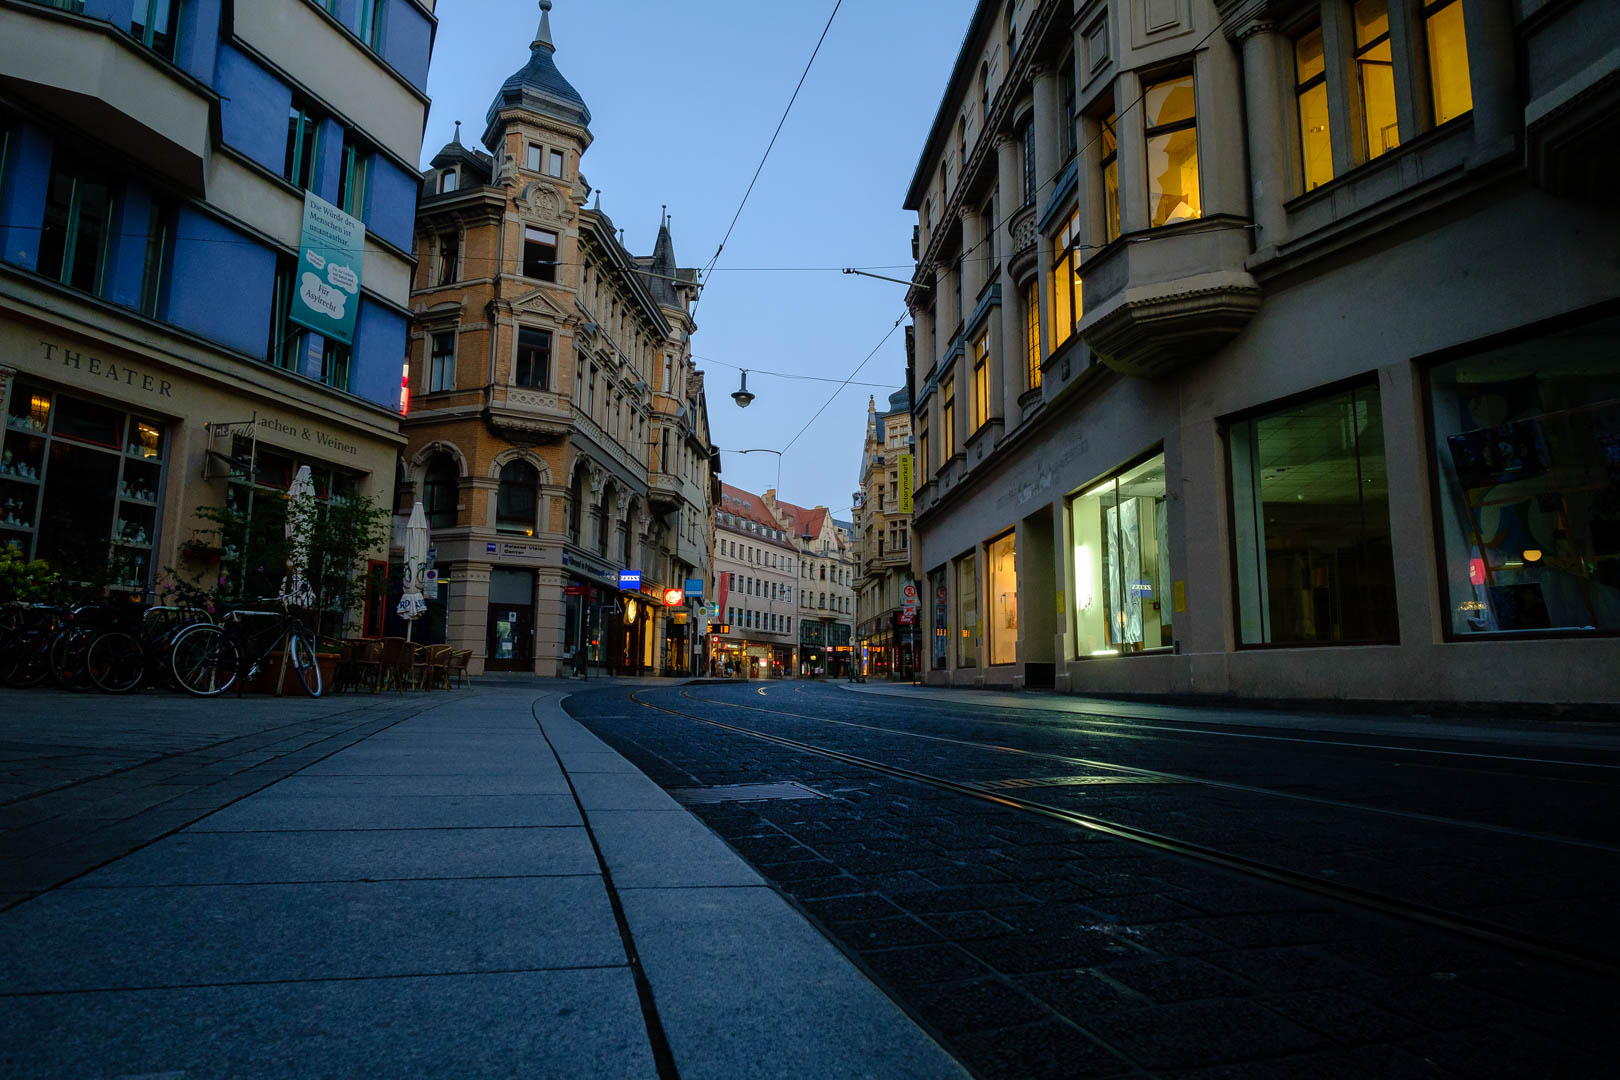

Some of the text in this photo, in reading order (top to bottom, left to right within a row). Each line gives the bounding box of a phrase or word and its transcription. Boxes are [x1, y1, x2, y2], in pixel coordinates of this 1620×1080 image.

[310, 201, 355, 229] Die Würde des
[310, 211, 352, 237] Menschen ist
[305, 289, 337, 313] Asylrecht
[318, 284, 330, 296] Für
[40, 341, 172, 398] THEATER
[256, 417, 357, 455] achen & Weinen
